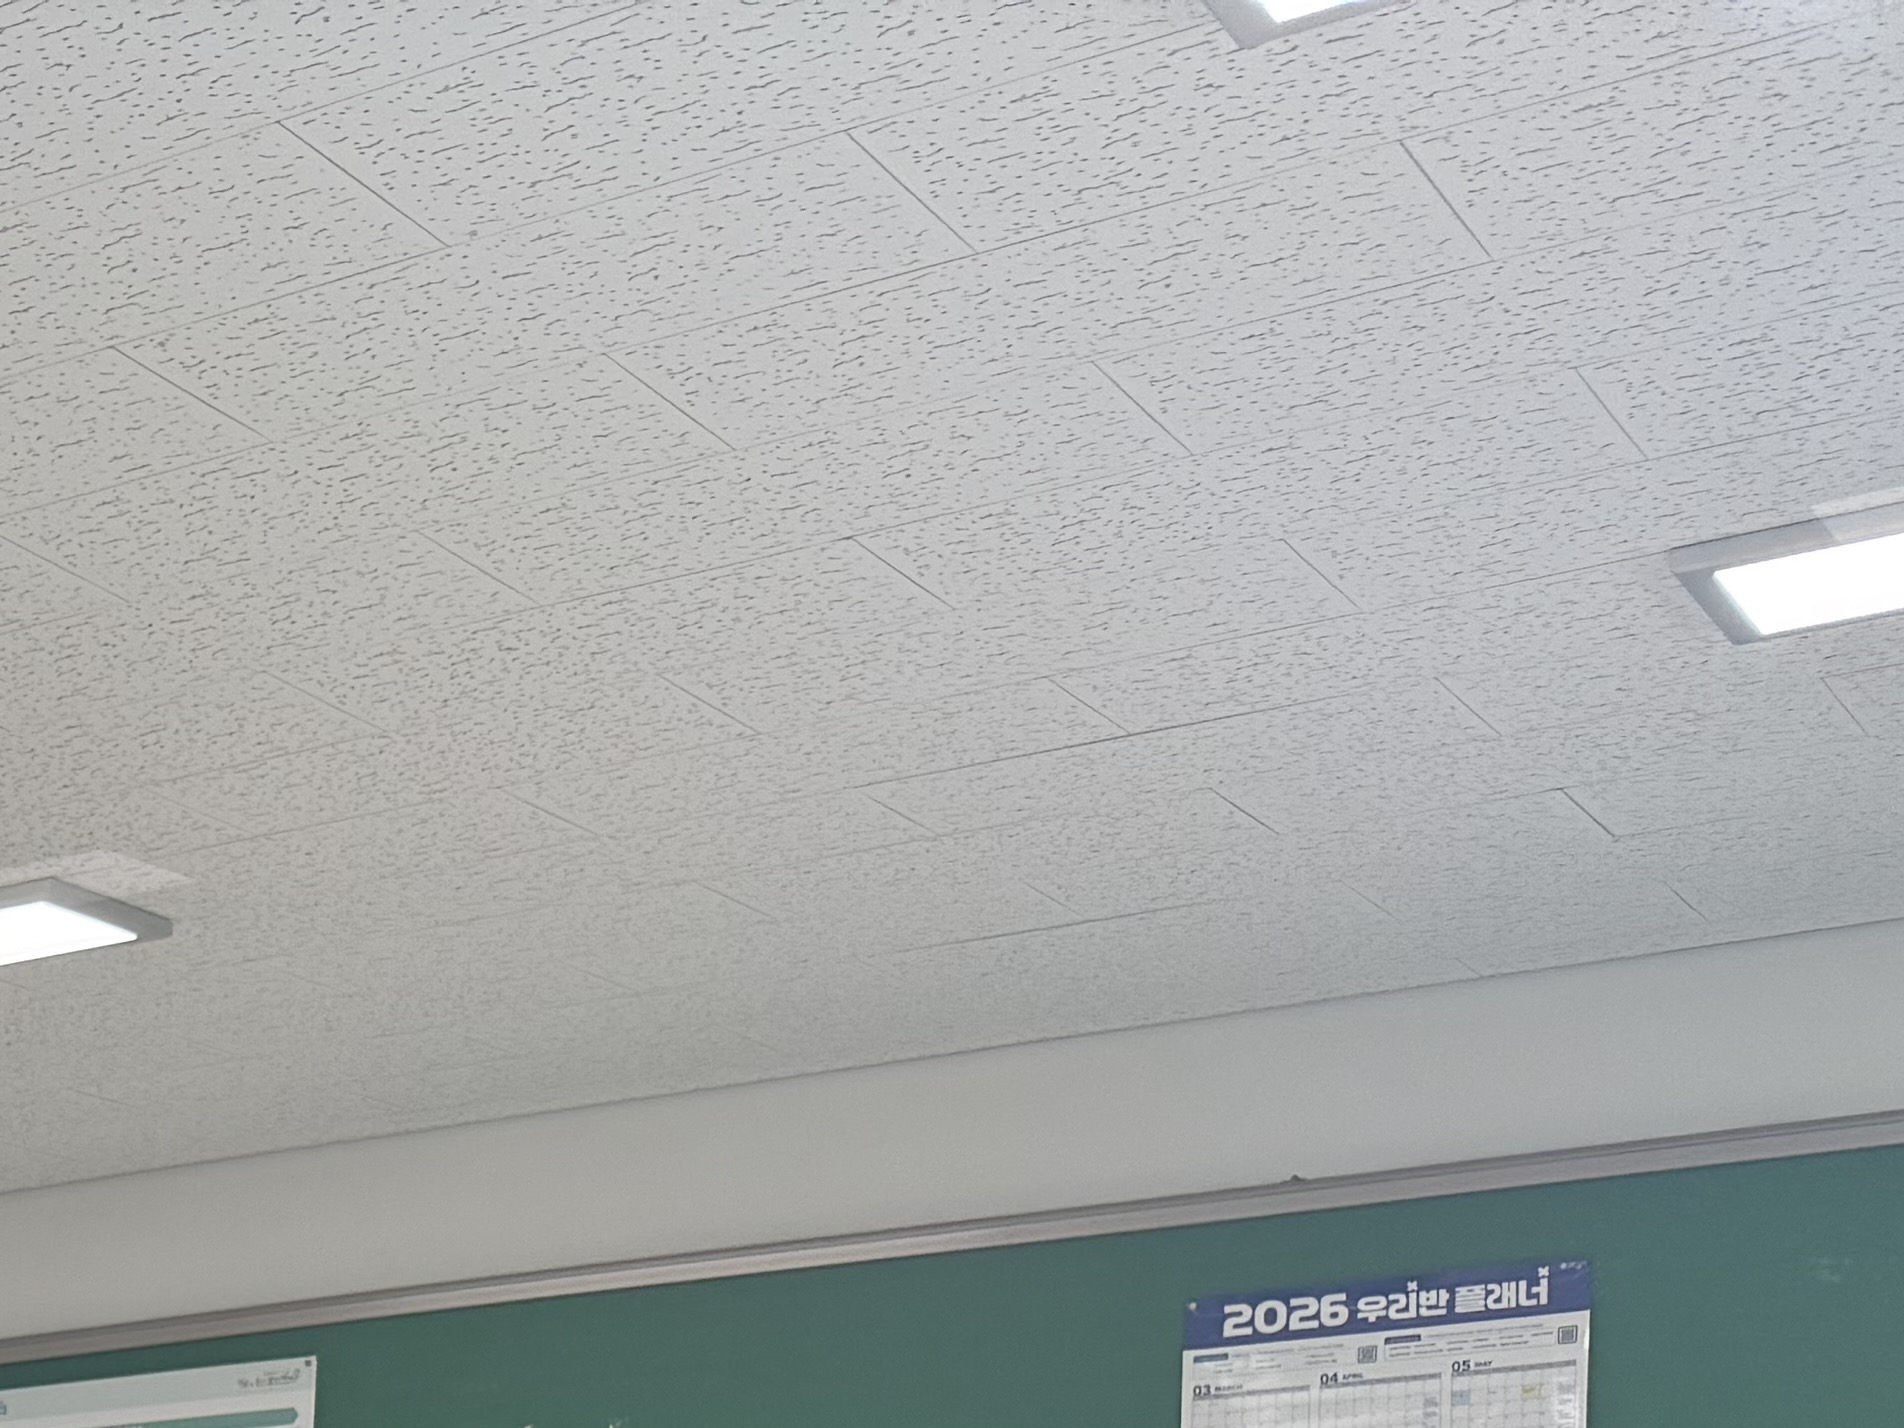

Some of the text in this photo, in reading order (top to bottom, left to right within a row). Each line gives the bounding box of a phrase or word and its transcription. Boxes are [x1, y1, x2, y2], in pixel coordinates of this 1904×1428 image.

[1222, 1266, 1550, 1338] 2026 우리반 플래너
[1452, 1360, 1470, 1373] 05
[1320, 1372, 1338, 1385] 04
[1193, 1385, 1211, 1396] 03
